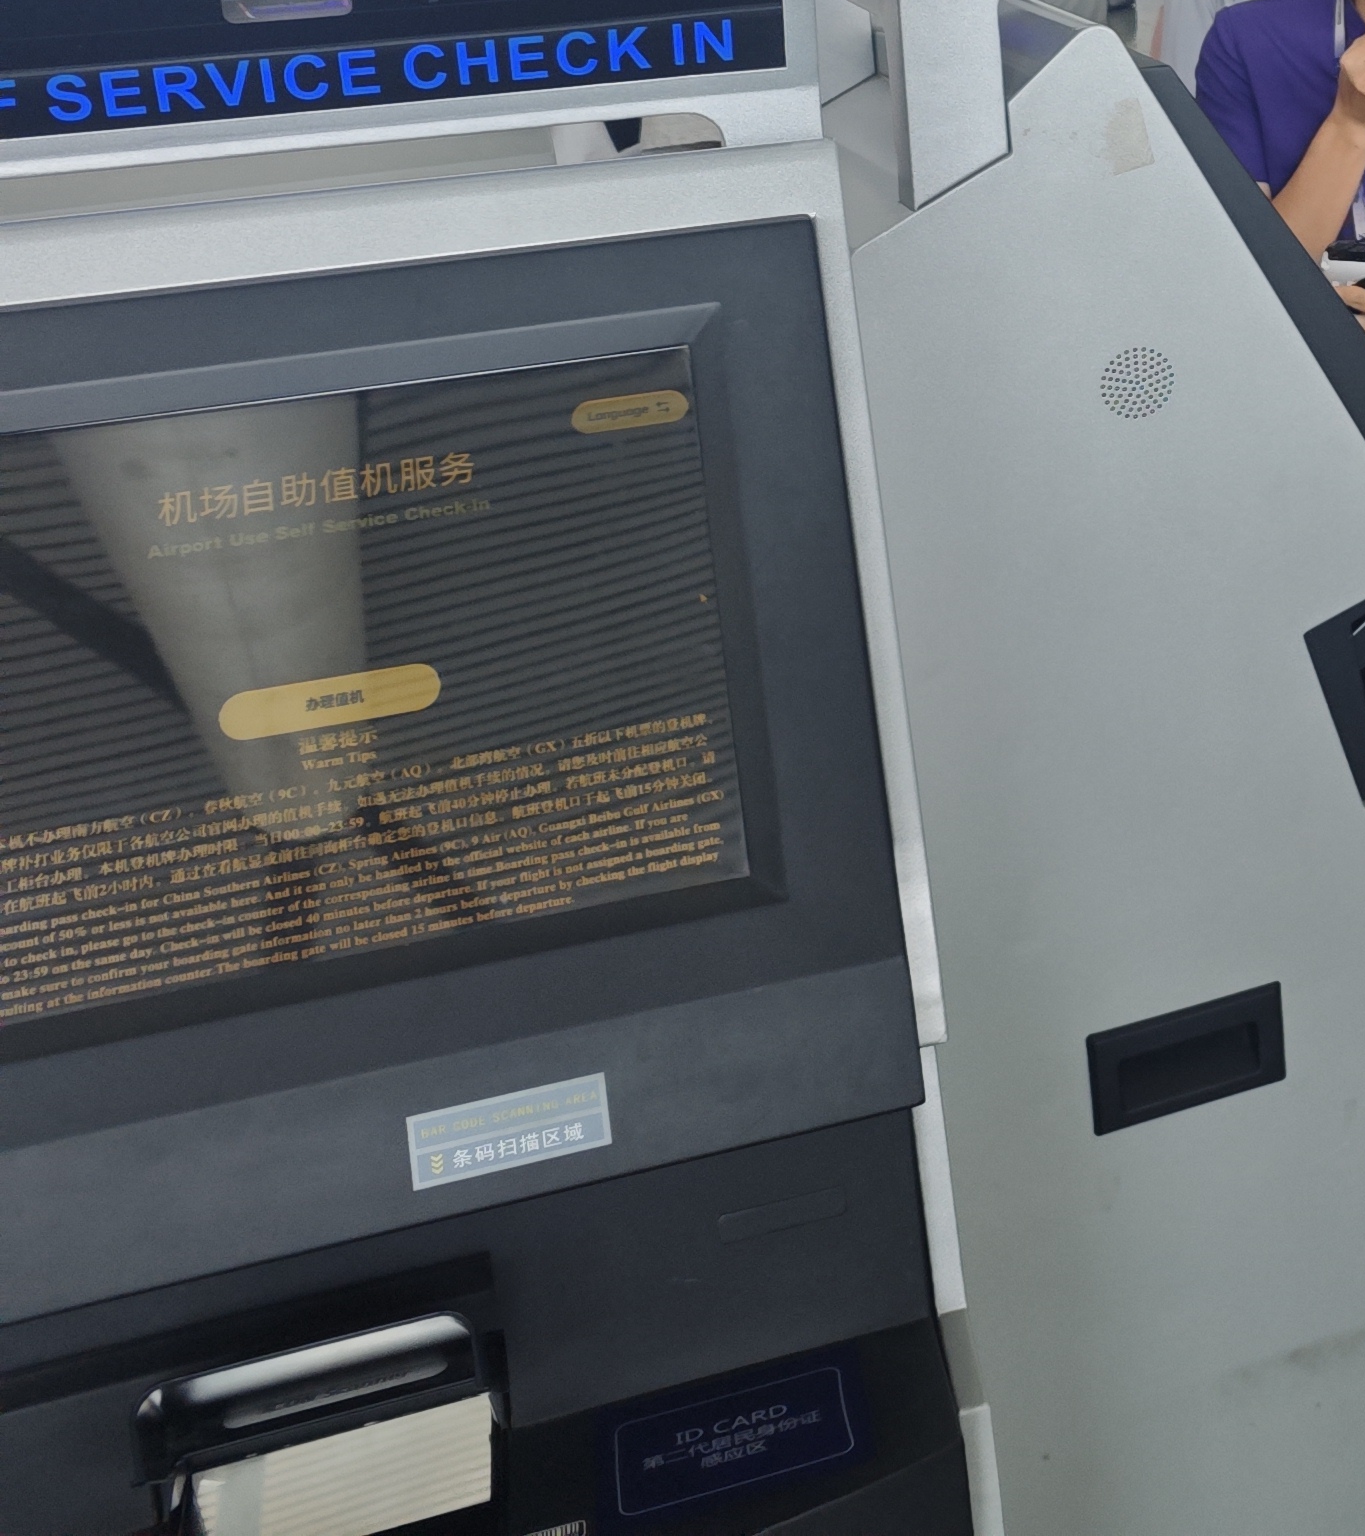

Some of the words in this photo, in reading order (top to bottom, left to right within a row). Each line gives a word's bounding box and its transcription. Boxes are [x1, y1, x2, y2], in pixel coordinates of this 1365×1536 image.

[46, 49, 381, 123] SERVICE
[403, 26, 652, 90] CHECK
[672, 19, 736, 66] IN
[586, 404, 651, 423] Language
[157, 452, 476, 528] 机场自助值机服务
[147, 536, 223, 560] Airport
[229, 529, 269, 547] Use
[275, 520, 316, 541] Self
[321, 509, 399, 534] Service
[305, 690, 366, 712] 办理值机
[298, 727, 379, 754] 温馨提示
[302, 752, 345, 771] Warm
[348, 748, 378, 766] Tips
[20, 947, 56, 964] check
[81, 935, 119, 955] please
[237, 903, 284, 921] counter
[324, 879, 409, 907] corresponding
[412, 871, 450, 888] airline
[550, 849, 575, 863] pass
[640, 825, 690, 843] available
[692, 819, 720, 833] from
[51, 914, 77, 929] pass
[162, 888, 200, 905] China
[203, 877, 259, 897] Southern
[263, 867, 310, 885] Airlines
[348, 853, 388, 872] Spring
[391, 843, 437, 861] Airlines
[538, 816, 585, 836] Guangxi
[588, 809, 620, 824] Beibu
[623, 803, 649, 817] Gulf
[652, 795, 694, 811] Airlines
[109, 917, 131, 931] less
[172, 899, 226, 919] available
[329, 875, 354, 891] only
[375, 862, 421, 880] handled
[462, 846, 502, 863] official
[505, 838, 547, 855] website
[564, 830, 590, 844] each
[1, 983, 36, 1000] make
[39, 980, 68, 993] sure
[87, 963, 136, 983] confirm
[140, 960, 169, 976] your
[172, 945, 228, 969] boarding
[231, 940, 258, 957] gate
[260, 925, 331, 949] information
[353, 915, 381, 930] later
[384, 909, 411, 924] than
[424, 900, 458, 916] hours
[460, 893, 496, 909] before
[499, 881, 556, 904] departure
[575, 867, 625, 889] checking
[647, 857, 677, 874] flight
[679, 849, 719, 868] display
[13, 965, 48, 982] 23:59
[94, 952, 126, 966] same
[222, 927, 245, 941] will
[264, 915, 302, 932] closed
[322, 902, 369, 921] minutes
[373, 894, 410, 911] before
[490, 876, 515, 891] your
[519, 867, 550, 885] flight
[586, 851, 633, 872] assigned
[645, 839, 695, 860] boarding
[87, 974, 161, 999] information
[242, 947, 297, 971] boarding
[301, 942, 326, 959] gate
[329, 937, 351, 951] will
[371, 926, 407, 942] closed
[427, 913, 473, 931] minutes
[476, 905, 513, 921] before
[453, 1122, 585, 1169] 条码扫描区域
[643, 1410, 821, 1471] 第二代居民身份证
[675, 1427, 704, 1446] ID
[713, 1404, 788, 1433] CARD
[700, 1440, 768, 1469] 感应区
